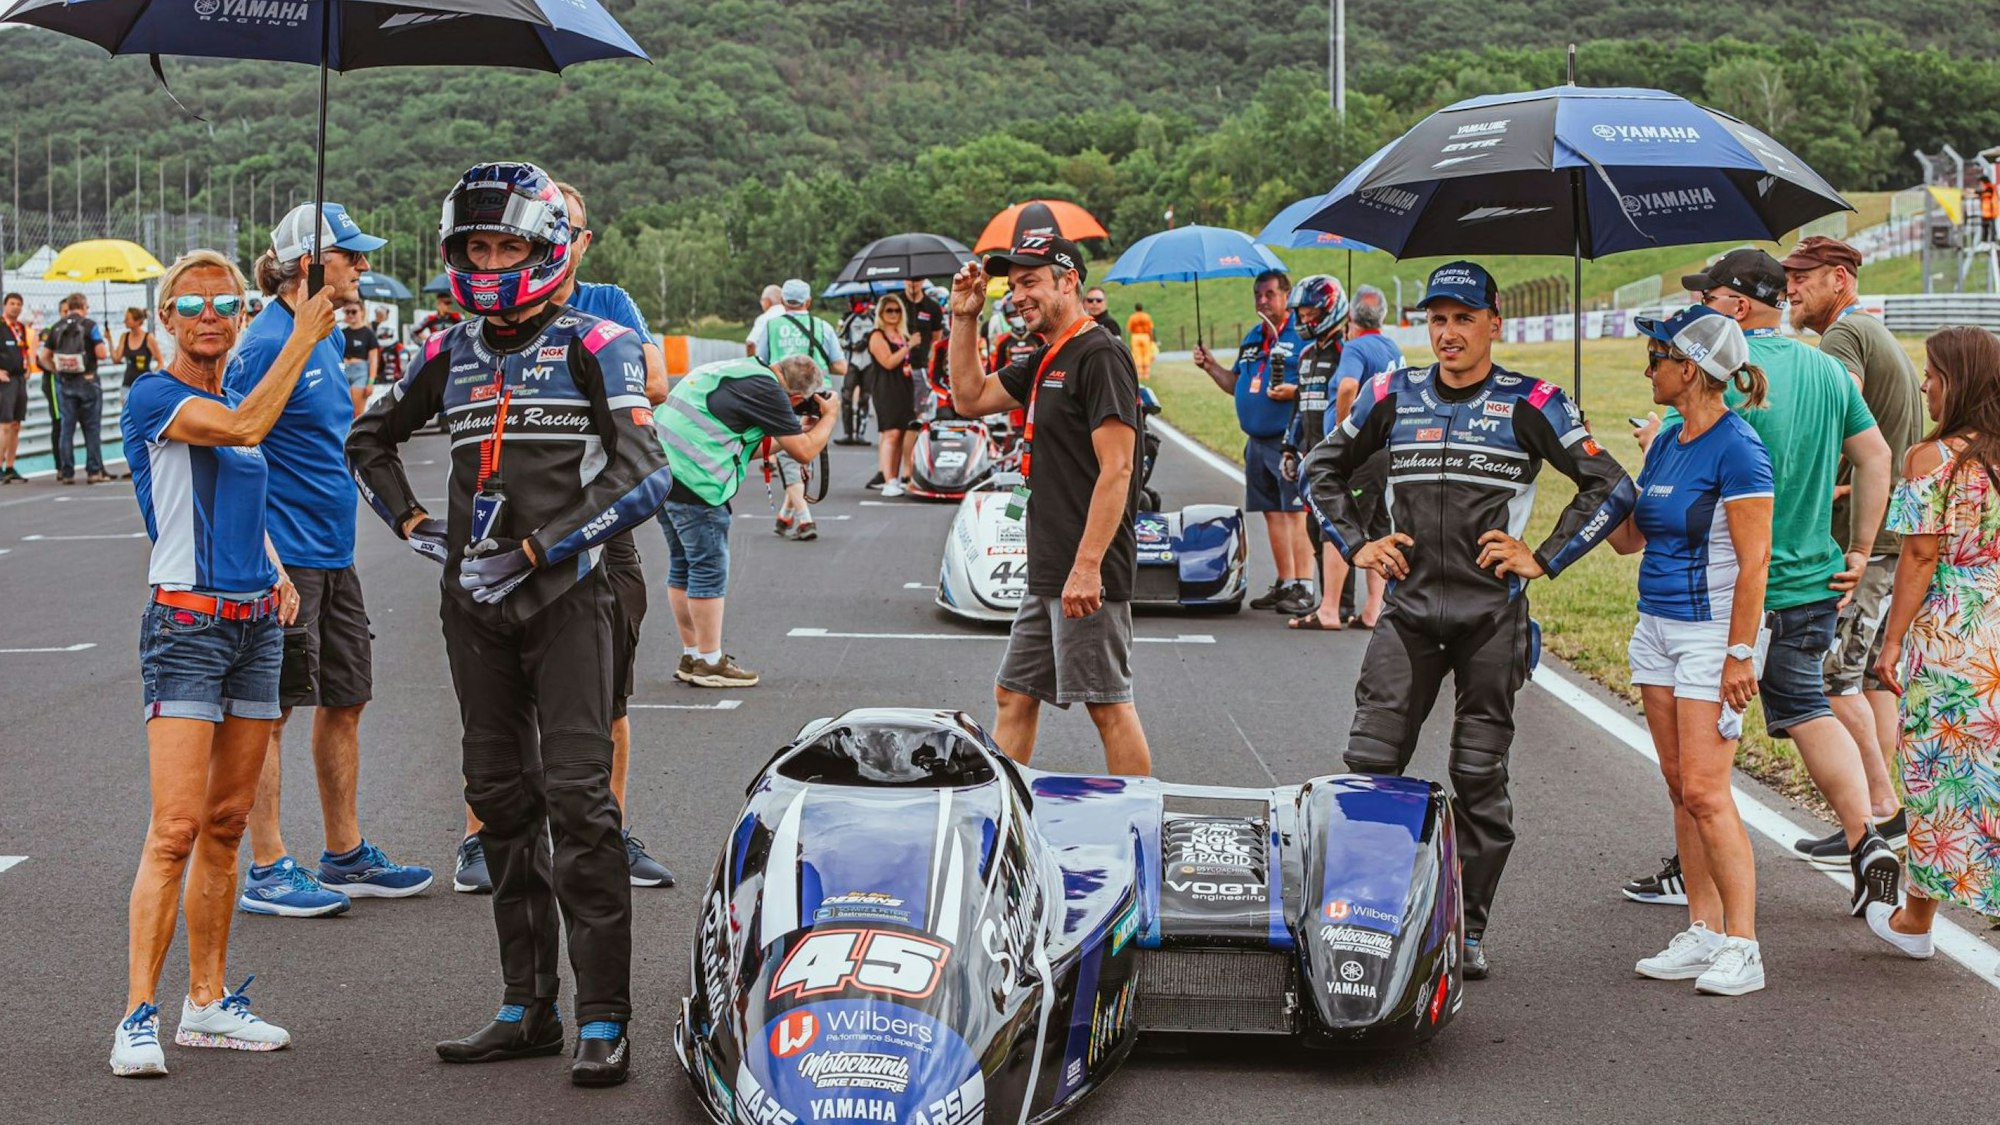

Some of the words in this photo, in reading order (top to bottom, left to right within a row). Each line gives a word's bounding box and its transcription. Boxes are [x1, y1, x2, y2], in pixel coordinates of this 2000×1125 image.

[222, 0, 309, 20] YAMAHA
[199, 15, 298, 27] RACING
[1457, 119, 1511, 135] YAMALUBE
[1615, 125, 1701, 139] YAMAHA
[1358, 198, 1405, 216] RACING
[1372, 184, 1420, 211] YAMAHA
[1638, 187, 1717, 211] YAMAHA
[1632, 204, 1714, 217] RACING
[473, 292, 499, 301] MOTO
[472, 339, 491, 364] YAMAHA
[520, 334, 549, 358] YAMAHA
[541, 348, 564, 356] NGK
[1687, 343, 1709, 362] 45
[522, 366, 554, 381] MVT
[1420, 389, 1438, 410] YAMAHA
[1467, 390, 1492, 410] YAMAHA
[1486, 403, 1510, 413] NGK
[523, 407, 591, 433] Racing
[1468, 418, 1500, 432] MVT
[1467, 453, 1522, 480] Racing
[990, 562, 1028, 585] 44
[1191, 835, 1239, 846] NGK
[1199, 853, 1251, 866] PAGID
[1167, 881, 1266, 895] VOGT
[821, 897, 904, 906] DESIGNS
[1192, 894, 1266, 902] engineering
[1352, 904, 1399, 924] Wilbers
[771, 930, 946, 997] 45
[1327, 982, 1377, 998] YAMAHA
[826, 1010, 933, 1043] Wilbers
[826, 1034, 882, 1042] Performance
[884, 1035, 933, 1053] Suspension
[816, 1077, 848, 1088] BIKE
[850, 1078, 906, 1093] DEKORE
[748, 1088, 798, 1125] ARS
[810, 1098, 897, 1122] YAMAHA
[915, 1092, 960, 1125] ARS
